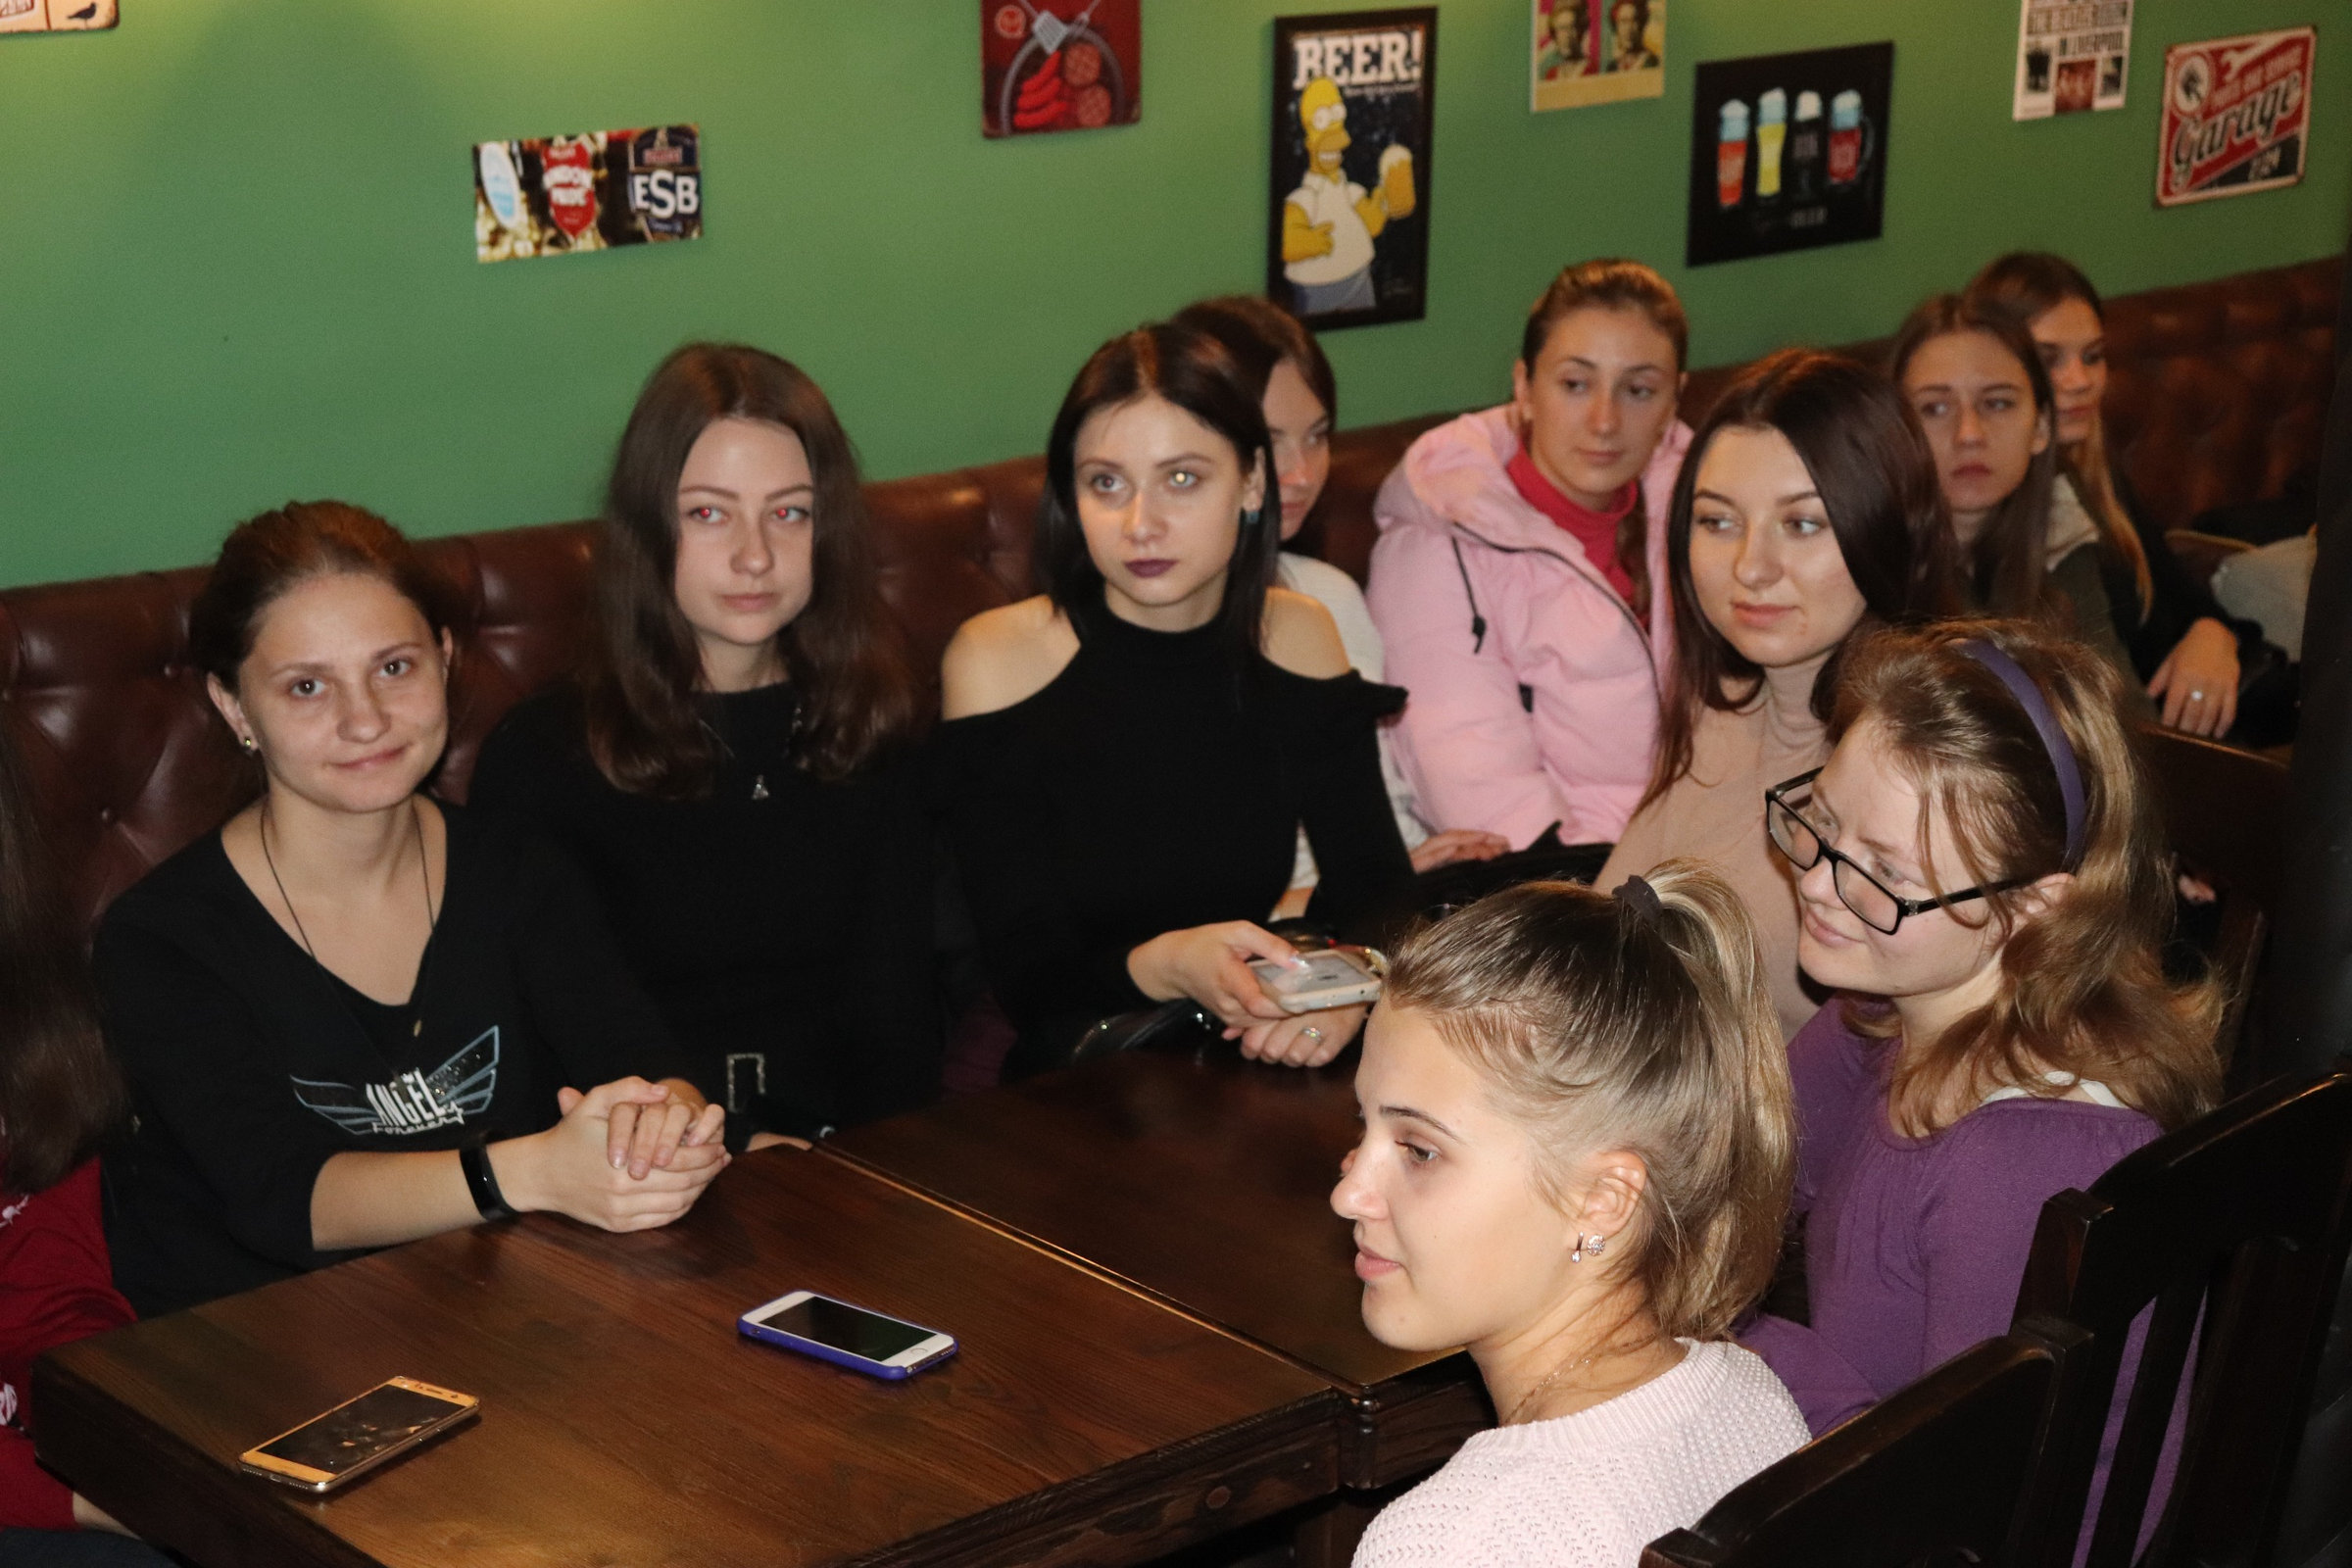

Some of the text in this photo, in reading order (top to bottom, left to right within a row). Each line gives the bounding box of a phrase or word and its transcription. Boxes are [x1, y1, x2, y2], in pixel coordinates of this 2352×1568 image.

[1293, 30, 1422, 90] BEER!
[633, 169, 699, 219] ESB
[366, 1067, 446, 1127] ANGEL
